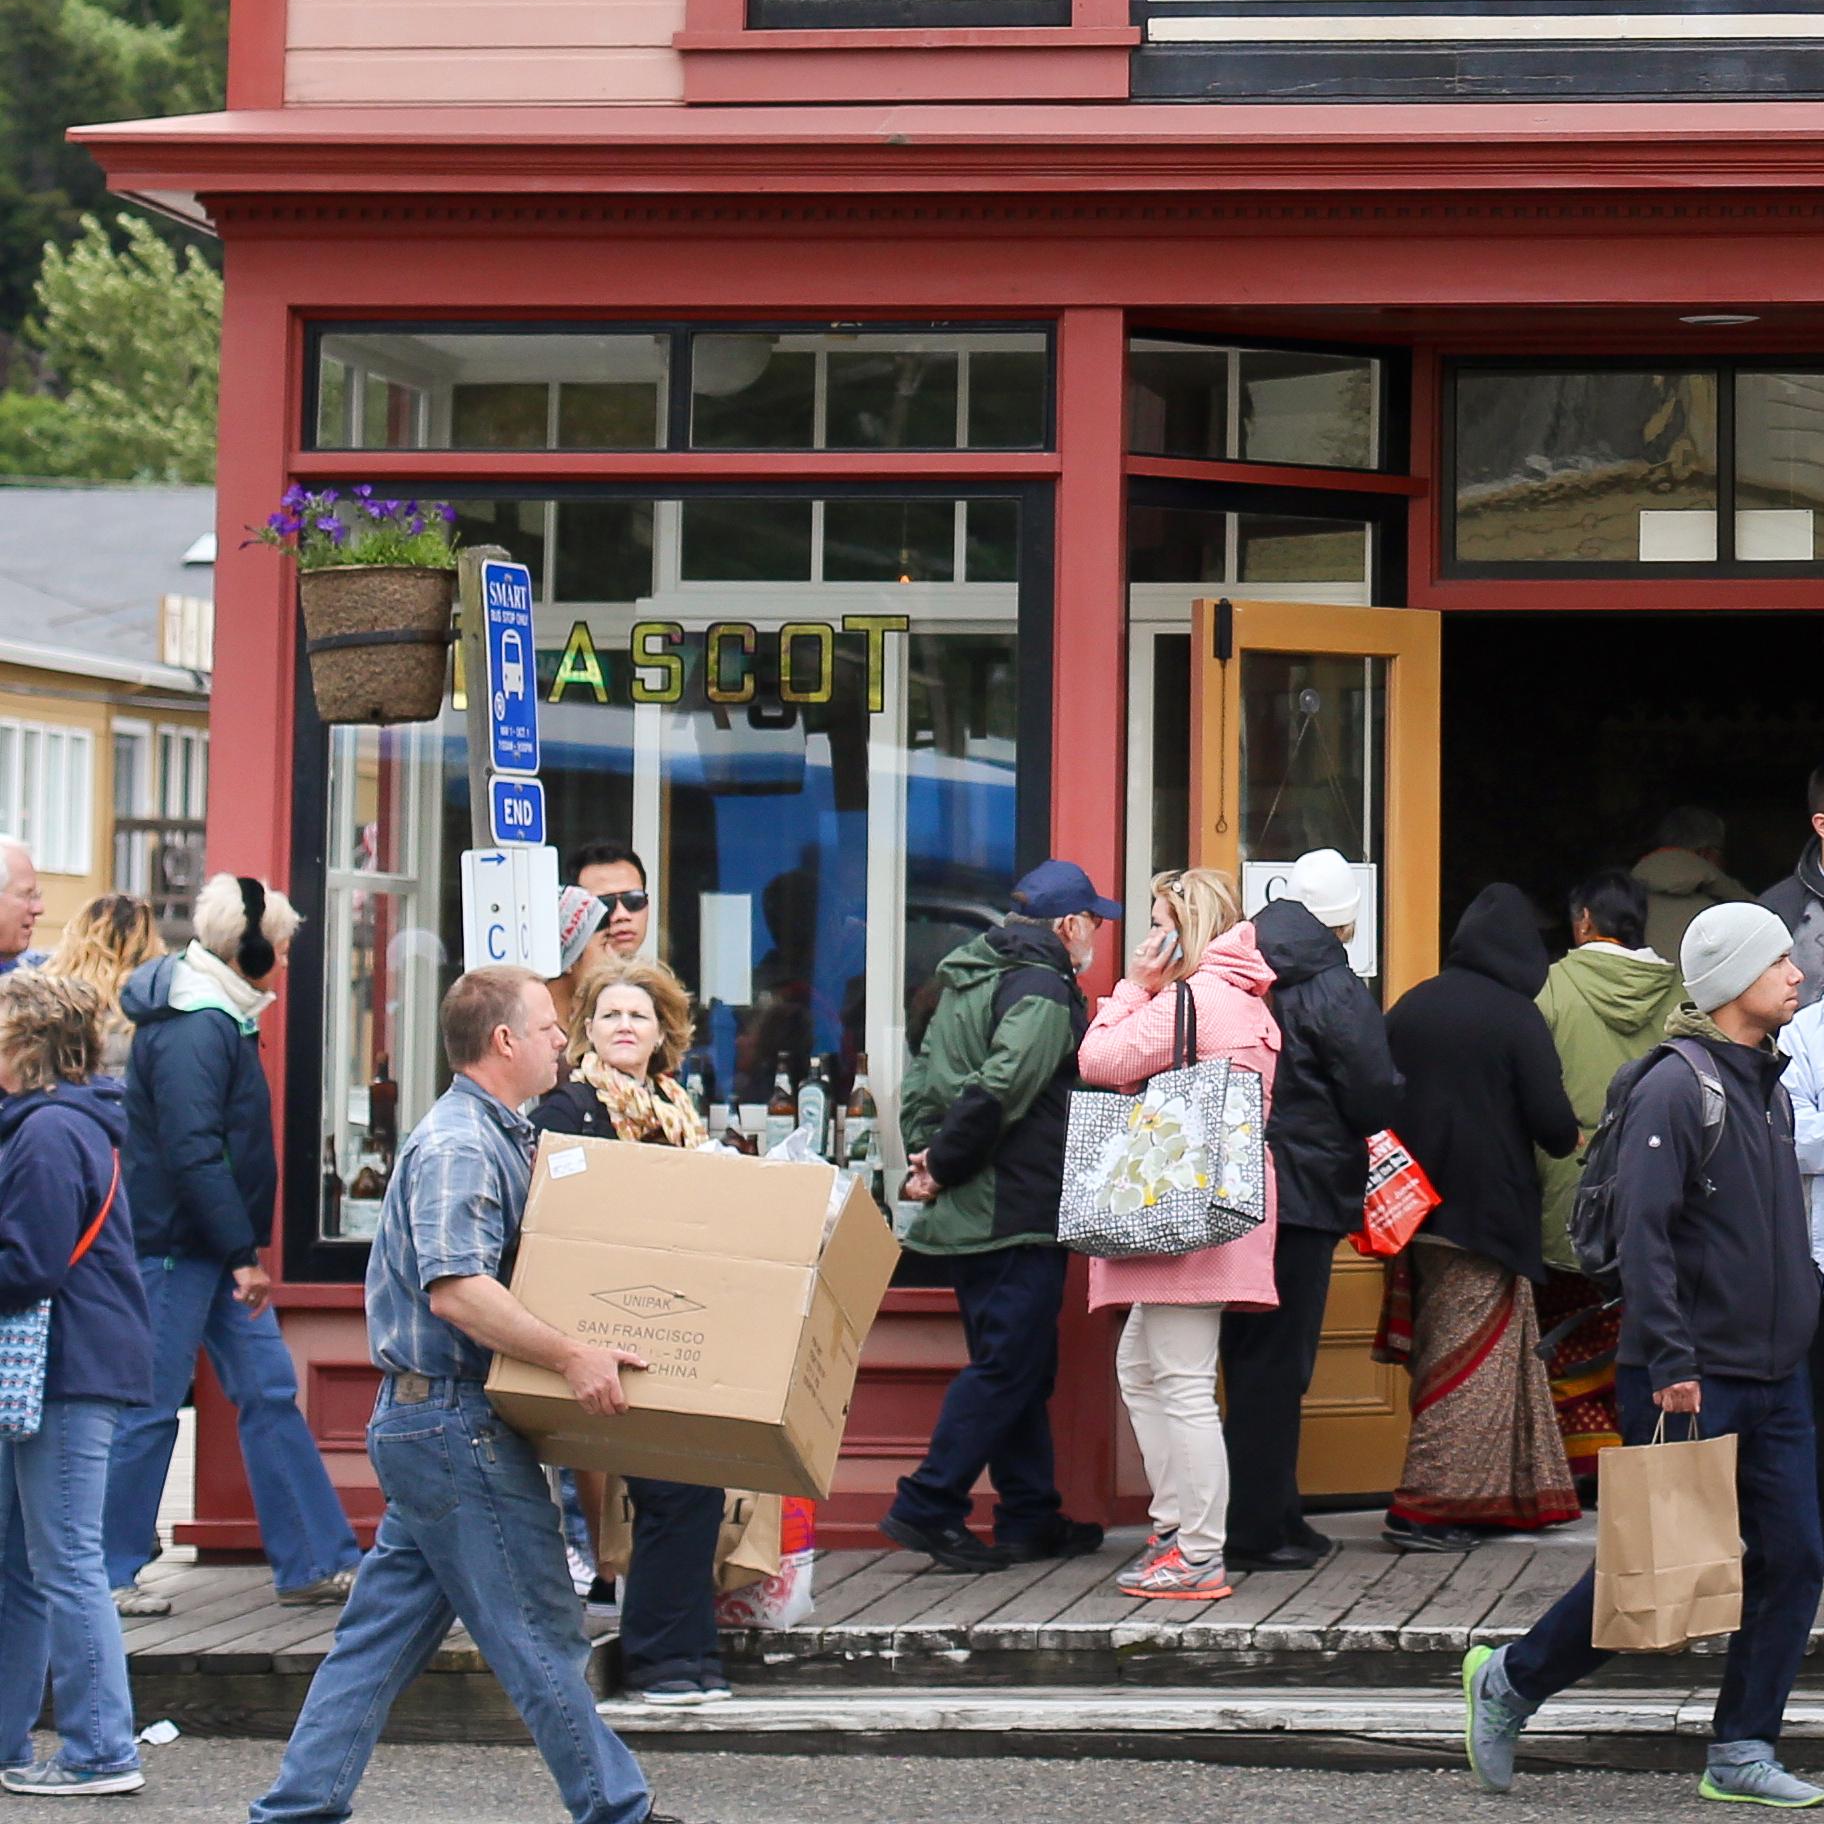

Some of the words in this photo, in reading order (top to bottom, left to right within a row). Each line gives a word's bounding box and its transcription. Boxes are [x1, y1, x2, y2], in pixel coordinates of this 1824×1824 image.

[489, 581, 527, 610] SMART
[502, 610, 515, 625] STOP
[451, 614, 910, 714] ASCOT
[504, 797, 533, 826] END
[623, 1294, 671, 1310] UNIPAK
[577, 1320, 609, 1334] SAN
[612, 1323, 705, 1344] FRANCISCO
[674, 1348, 701, 1362] 300
[647, 1363, 698, 1379] CHINA
